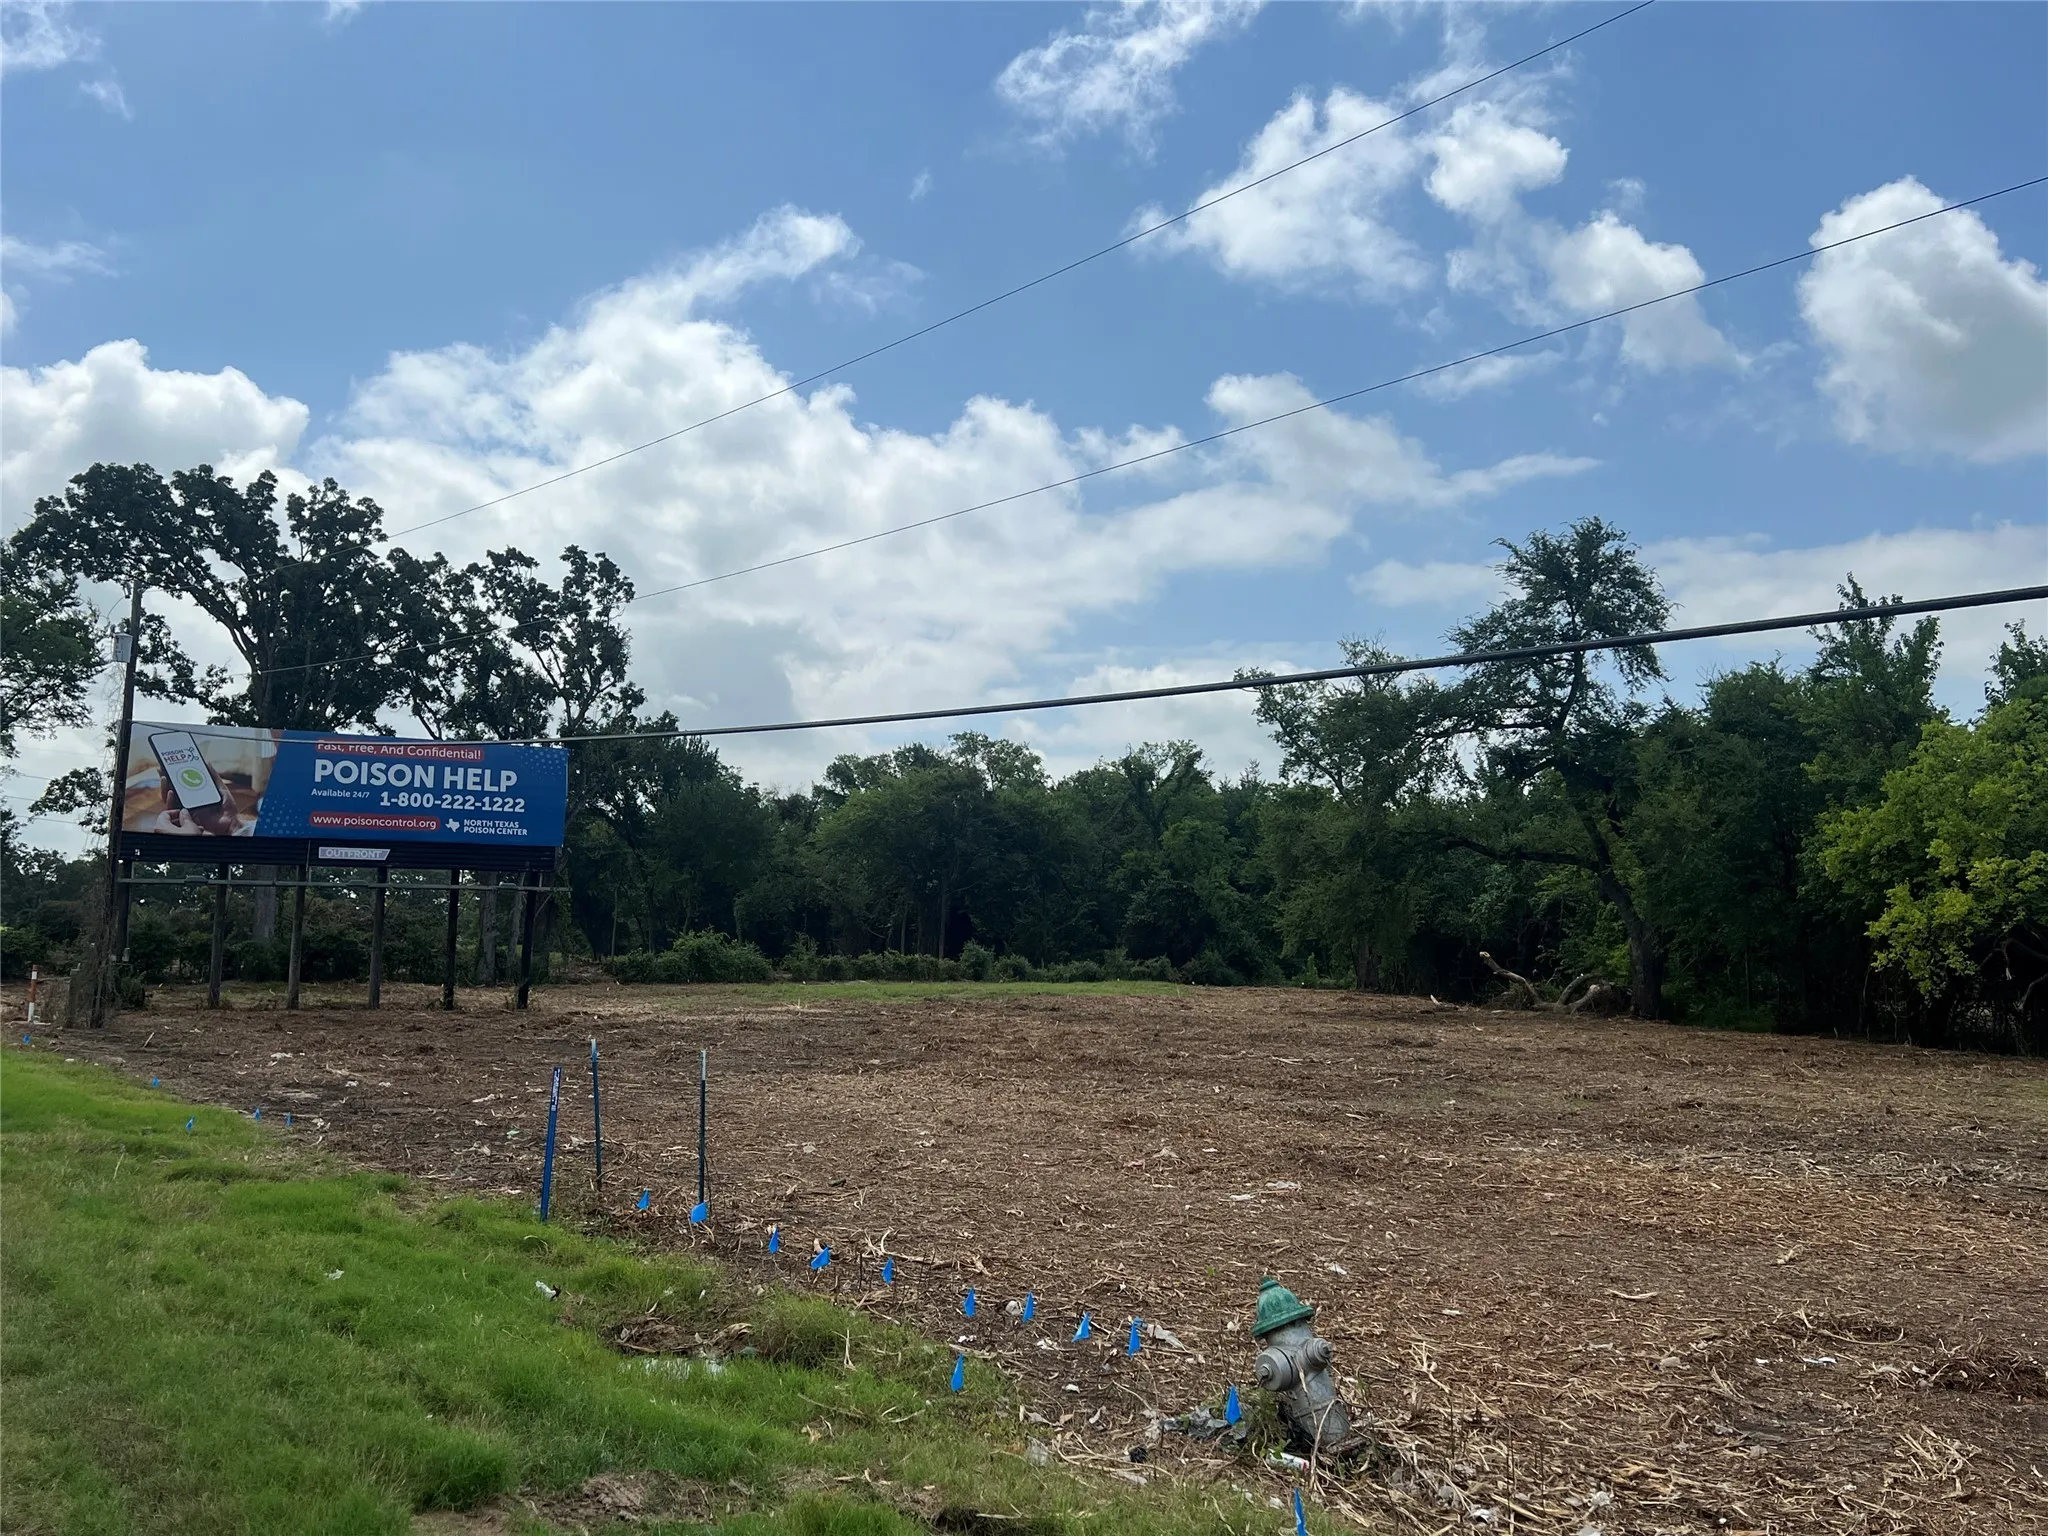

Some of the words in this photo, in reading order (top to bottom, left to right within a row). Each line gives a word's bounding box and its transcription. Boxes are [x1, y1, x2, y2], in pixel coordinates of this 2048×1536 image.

[380, 744, 404, 756] And
[407, 745, 482, 760] Confidential!
[314, 759, 435, 788] POISON
[443, 766, 518, 792] HELP
[311, 788, 351, 798] Available
[352, 790, 370, 799] 24/7
[379, 791, 525, 812] 1-800-222-1222
[313, 814, 437, 830] www.poisoncontrol.org
[463, 819, 493, 828] NORTH
[494, 820, 520, 829] TEXAS
[463, 826, 495, 835] POISON
[496, 828, 528, 836] CENTER
[325, 849, 382, 858] OUTFRONT
